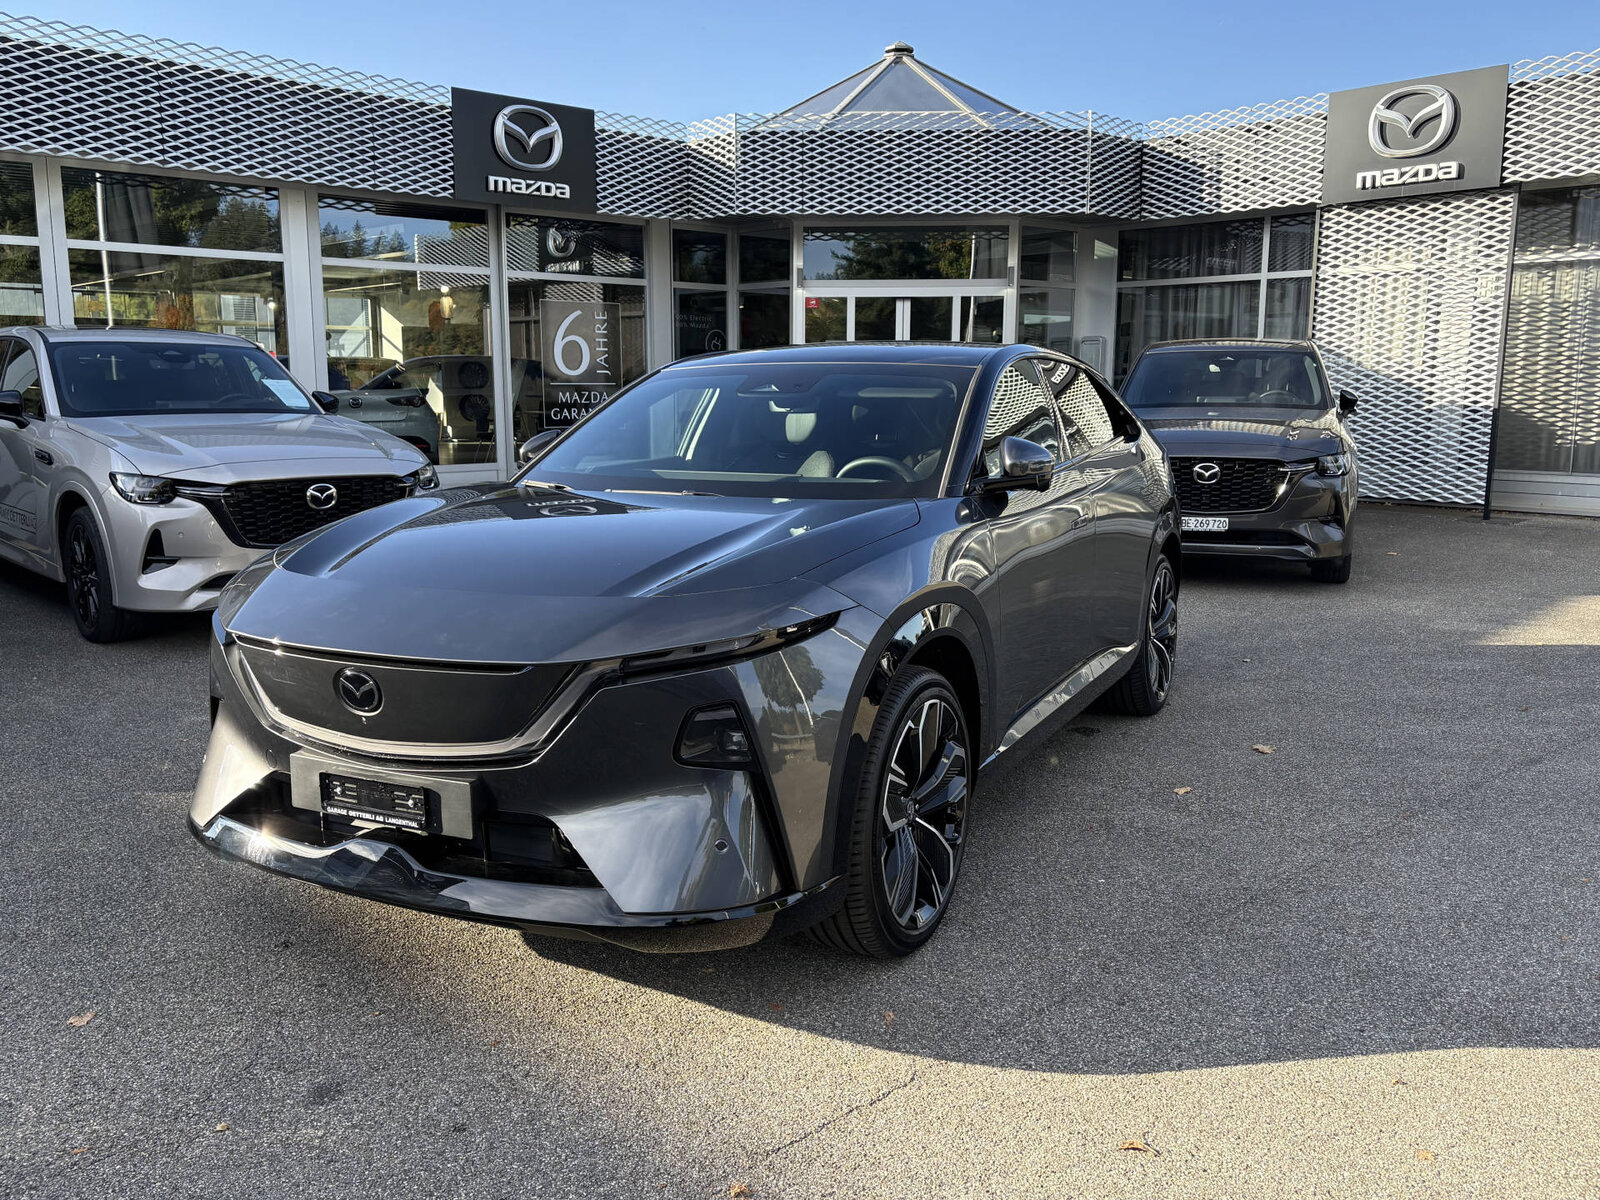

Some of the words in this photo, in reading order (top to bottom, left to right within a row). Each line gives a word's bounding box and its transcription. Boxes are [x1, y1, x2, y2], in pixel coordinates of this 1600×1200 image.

[487, 175, 570, 199] mazda
[1355, 161, 1459, 189] mazda
[553, 310, 591, 376] 6
[594, 310, 612, 376] JAHRE
[558, 391, 609, 404] MAZDA
[326, 806, 347, 815] GARAGE
[348, 809, 375, 820] OETTERLI
[385, 817, 419, 828] LANGENTHAL
